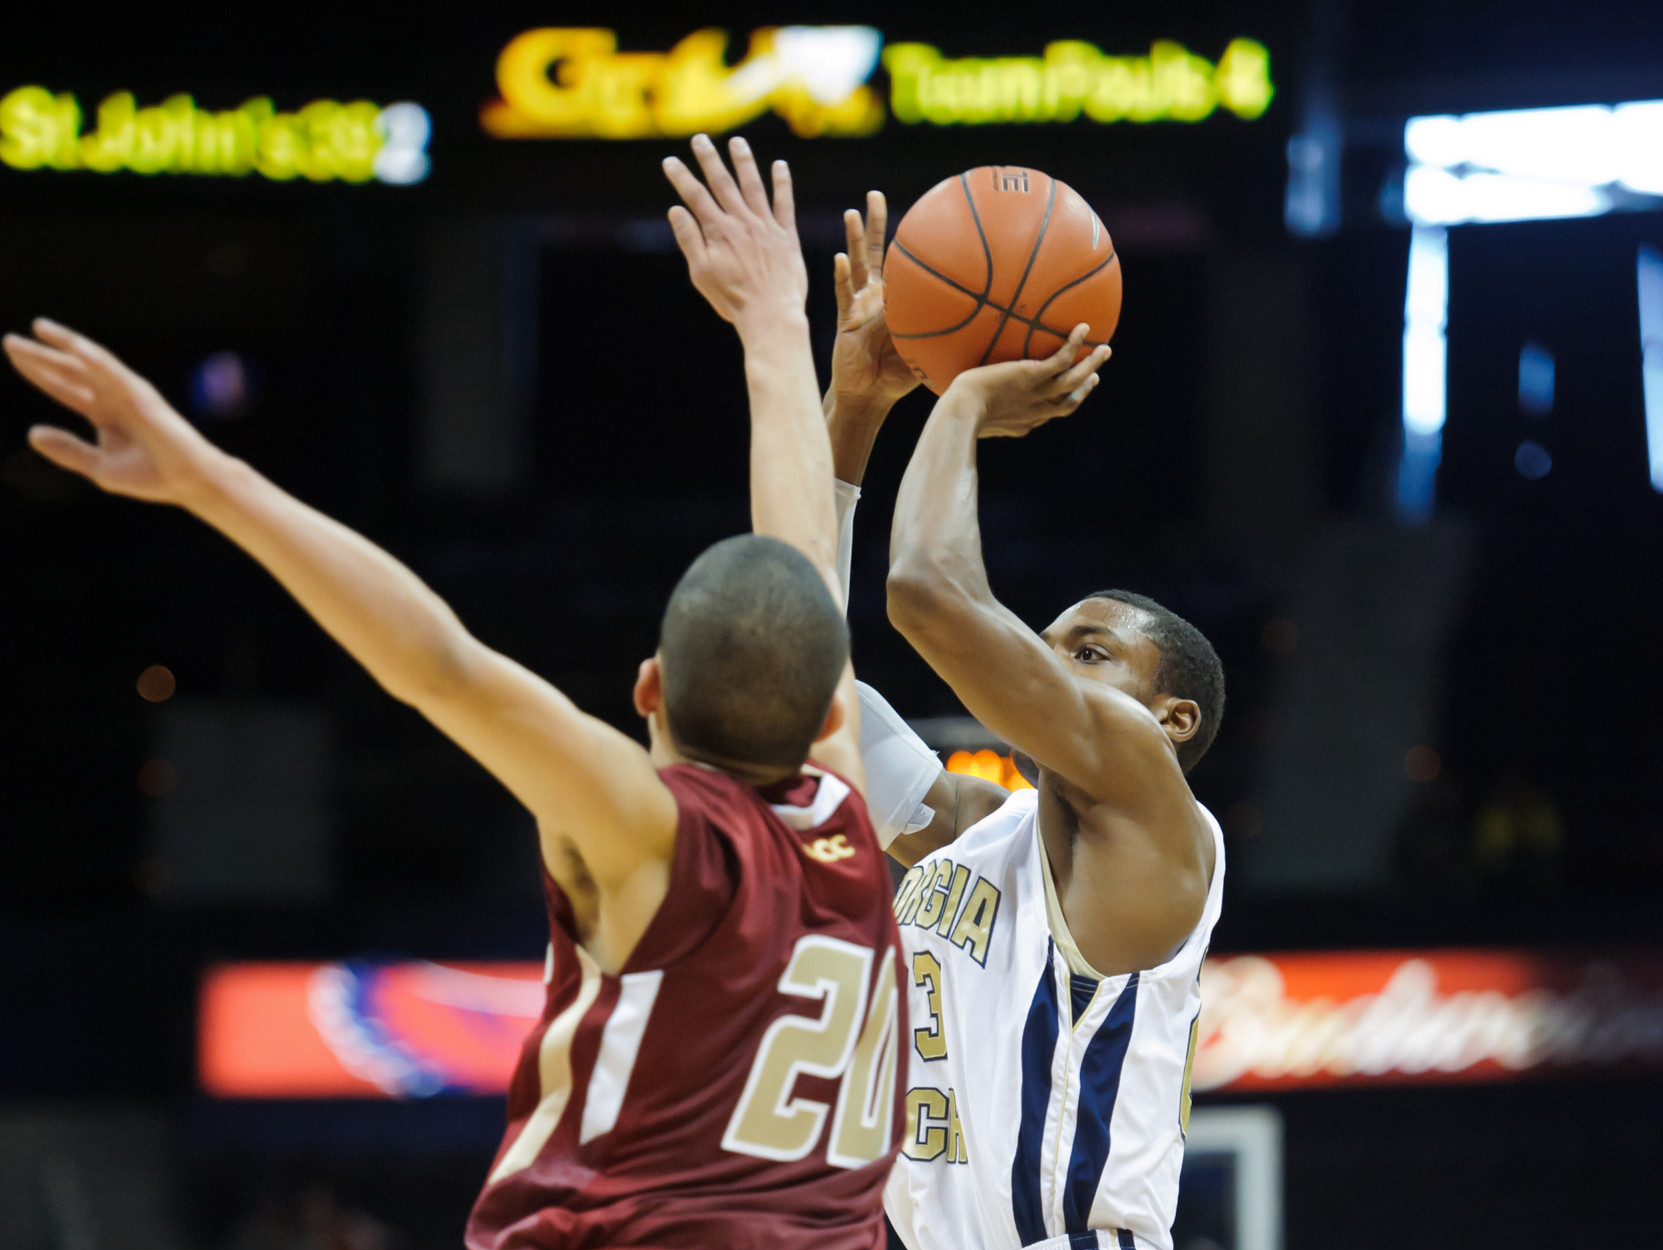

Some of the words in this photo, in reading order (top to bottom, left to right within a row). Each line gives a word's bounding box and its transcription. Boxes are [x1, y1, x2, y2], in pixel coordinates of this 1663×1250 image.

[802, 834, 856, 863] CC
[893, 858, 1002, 970] ORGIA
[720, 934, 898, 1170] 20
[901, 1086, 968, 1164] CH
